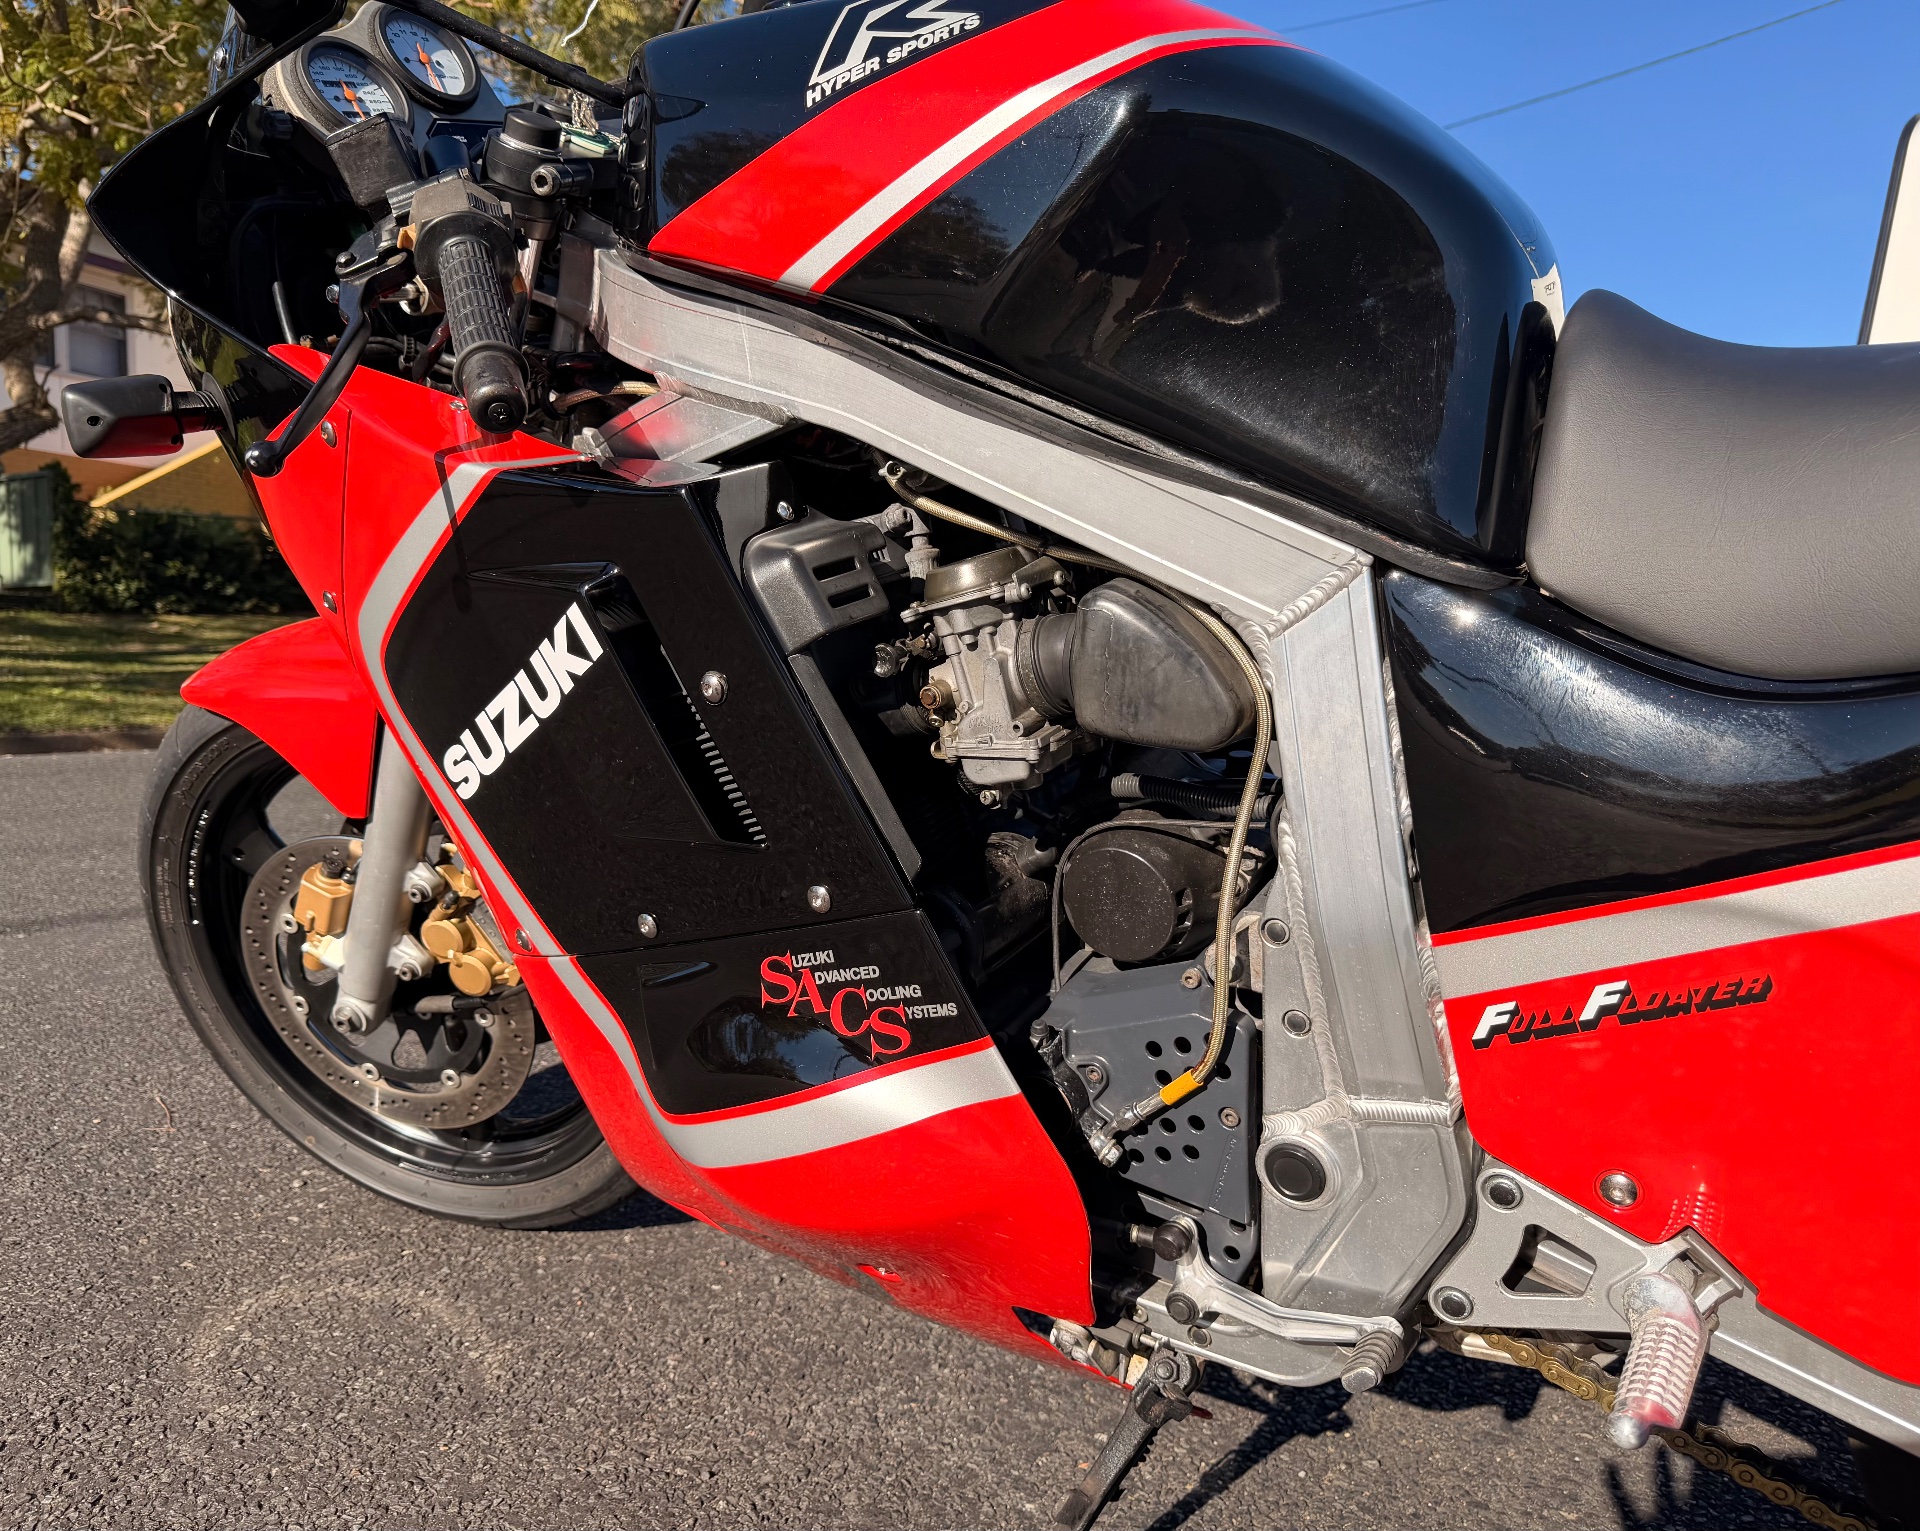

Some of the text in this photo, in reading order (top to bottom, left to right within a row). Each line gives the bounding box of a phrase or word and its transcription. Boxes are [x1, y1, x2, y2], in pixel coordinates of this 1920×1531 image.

[806, 14, 981, 108] HYPER SPORTS
[443, 601, 604, 800] SUZUKI
[1578, 973, 1773, 1032] FLOATER
